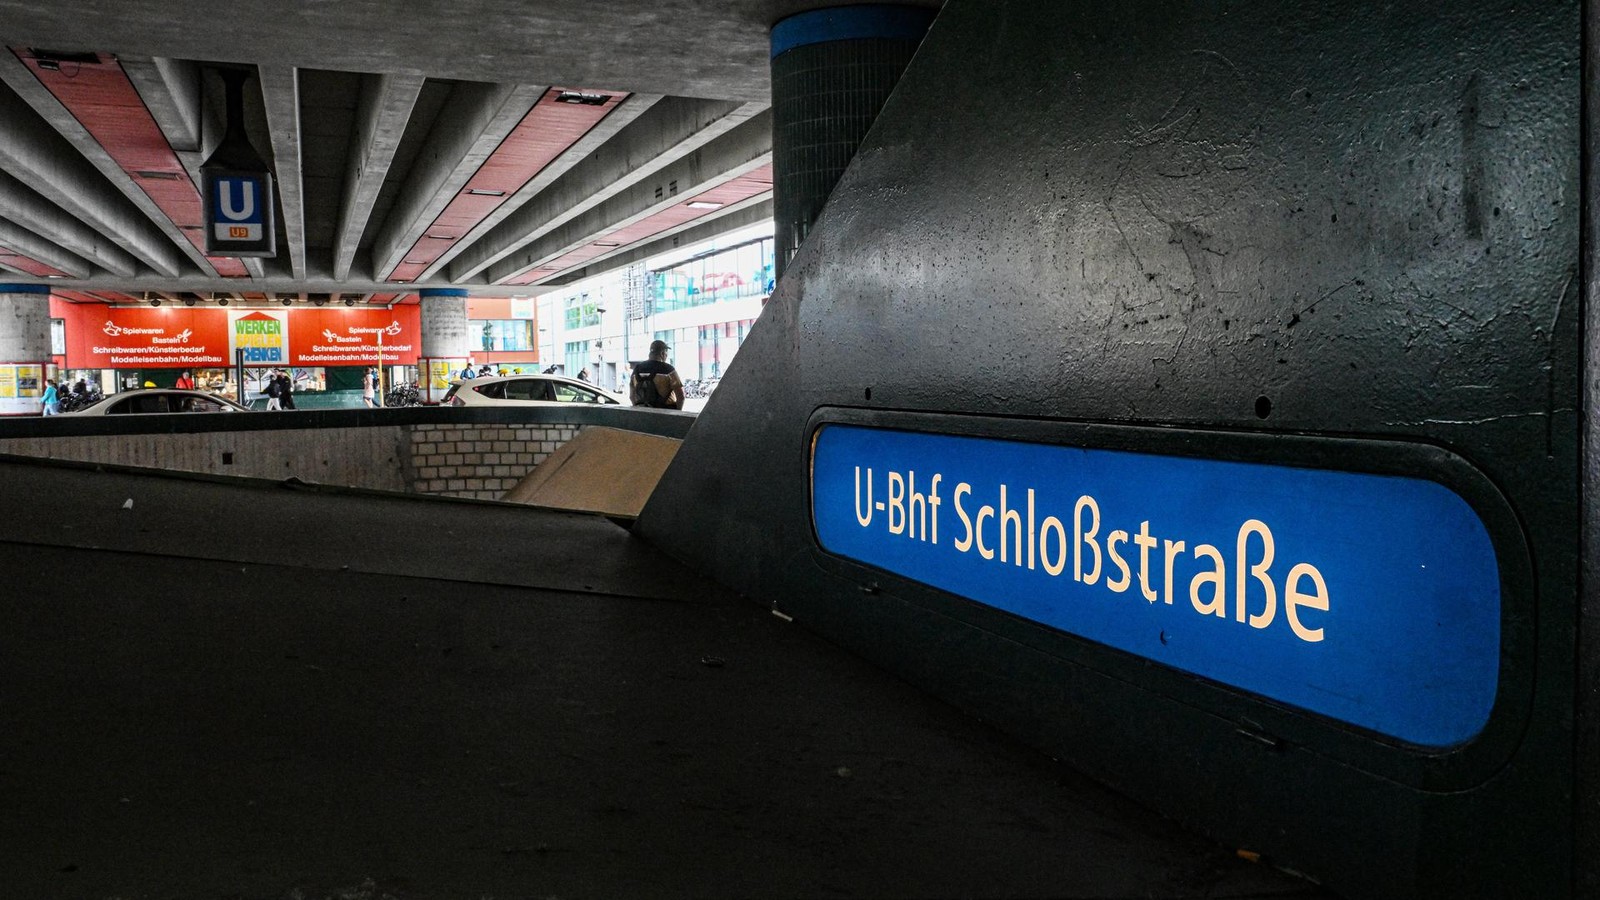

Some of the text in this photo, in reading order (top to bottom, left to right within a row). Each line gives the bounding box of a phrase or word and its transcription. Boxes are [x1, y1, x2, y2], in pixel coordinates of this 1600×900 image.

[219, 181, 254, 220] U
[231, 228, 247, 237] U9
[122, 327, 164, 335] Spielwaren
[235, 320, 281, 334] WERKEN
[92, 346, 205, 354] Schreibwaren/Künstlerbedarf
[237, 347, 282, 361] HENKEN
[110, 355, 222, 363] Modelleisenbahn/Modellbau
[855, 466, 1330, 642] U-Bhf Schloßstraße
